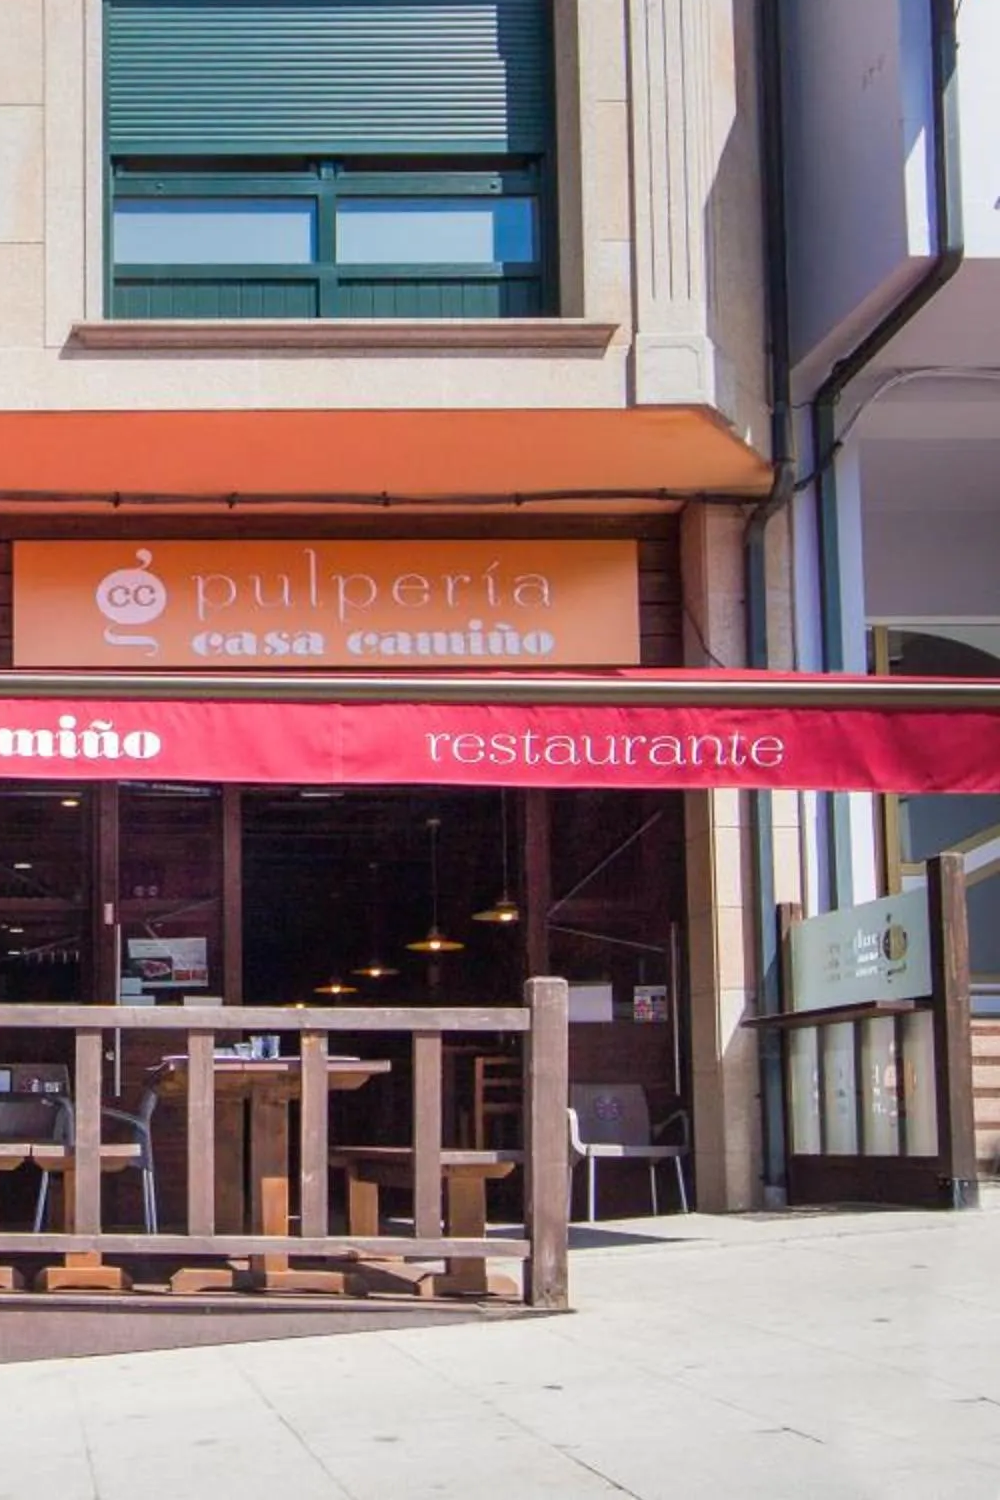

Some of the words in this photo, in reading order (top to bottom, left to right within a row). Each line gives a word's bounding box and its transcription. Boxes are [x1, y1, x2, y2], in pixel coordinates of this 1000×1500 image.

[191, 548, 552, 622] pulpería
[191, 629, 326, 656] casa
[347, 618, 555, 656] camiño
[425, 728, 785, 768] restaurante
